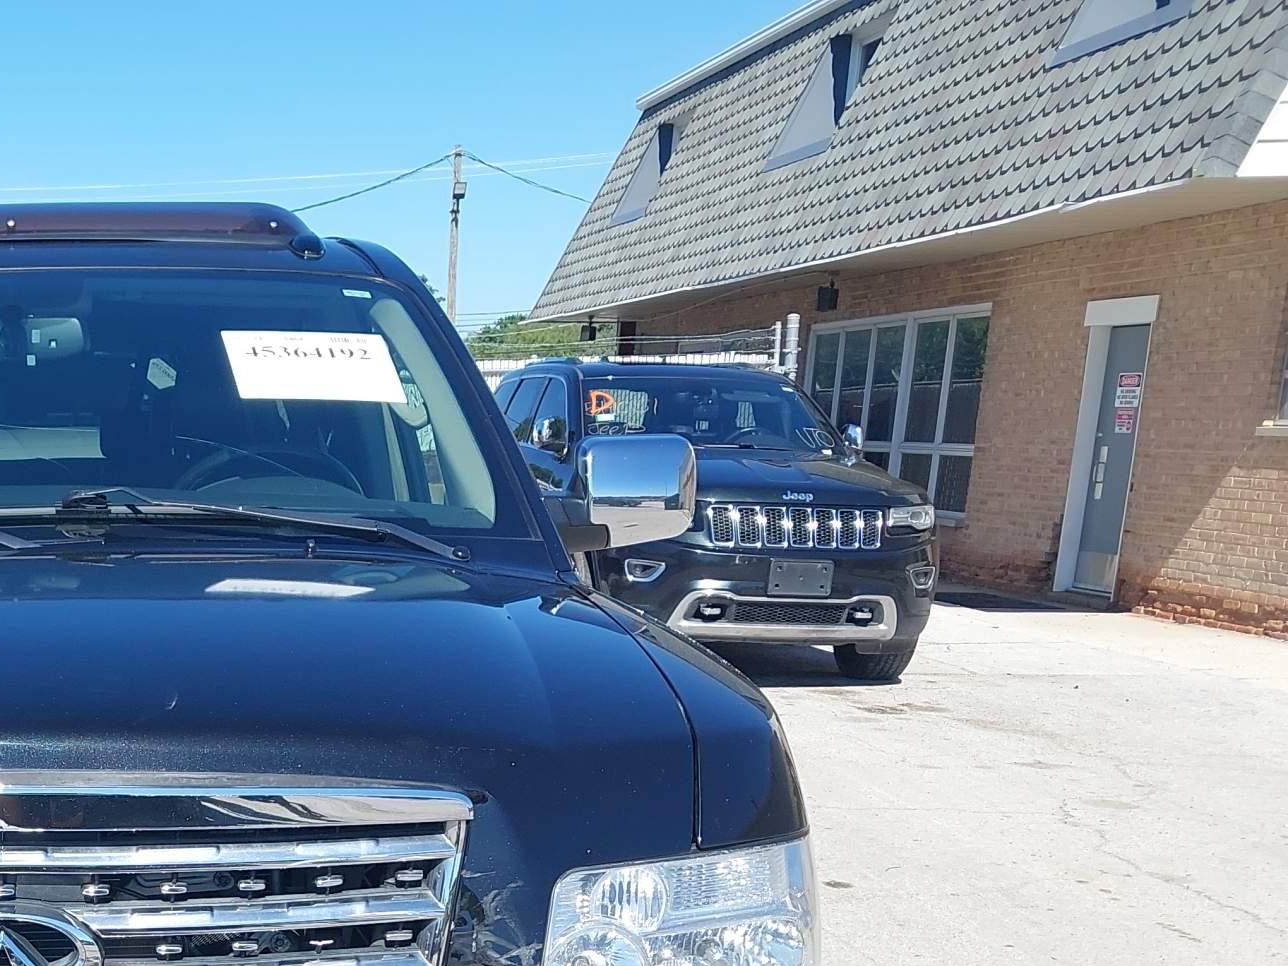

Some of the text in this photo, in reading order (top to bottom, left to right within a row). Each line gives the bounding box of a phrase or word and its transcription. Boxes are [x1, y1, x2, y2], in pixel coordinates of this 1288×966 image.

[246, 346, 372, 360] 45364192
[590, 391, 616, 415] D
[782, 490, 814, 502] Jeep
